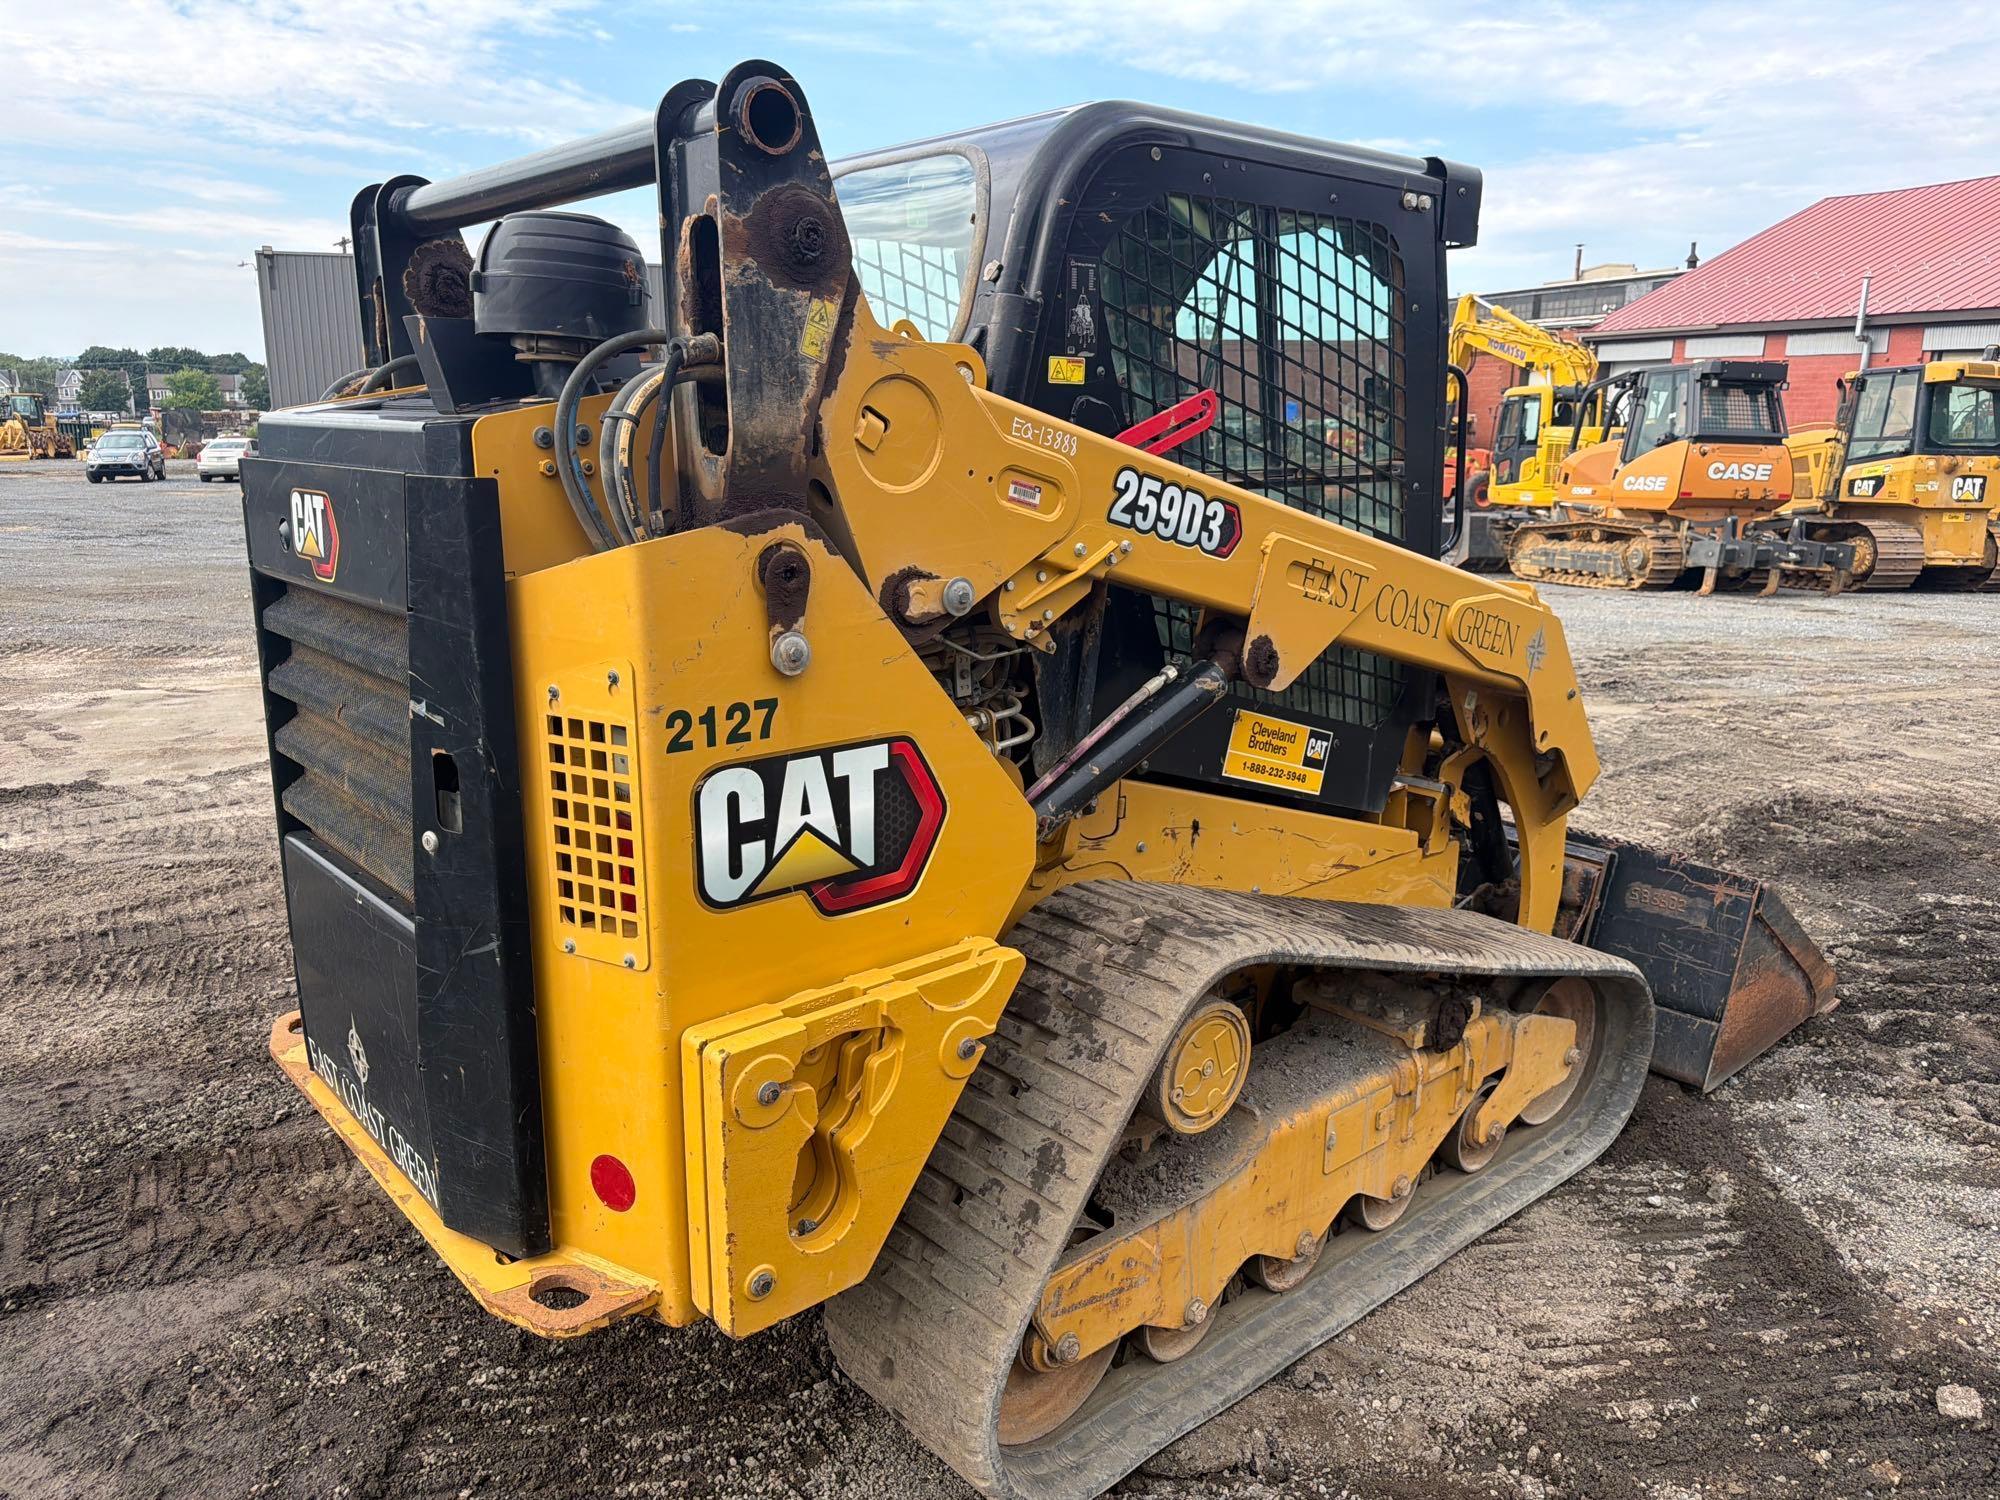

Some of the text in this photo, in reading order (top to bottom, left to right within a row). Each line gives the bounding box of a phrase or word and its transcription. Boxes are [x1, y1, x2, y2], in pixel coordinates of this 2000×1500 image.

[1487, 337, 1526, 361] KOMATSU
[1011, 416, 1079, 457] EQ-13888
[1707, 461, 1773, 481] CASE
[1622, 475, 1668, 492] CASE
[1853, 479, 1876, 496] CAT
[1951, 477, 1984, 501] CAT
[1109, 470, 1225, 552] 259D3
[291, 491, 325, 558] CAT
[1302, 557, 1521, 659] EAST COAST GREEN
[665, 697, 779, 755] 2127
[1251, 721, 1298, 744] Cleveland
[1248, 734, 1288, 757] Brothers
[1307, 737, 1328, 761] CAT
[1242, 760, 1307, 784] 1-888-232-5948
[699, 743, 889, 903] CAT
[307, 1036, 439, 1208] EAST COAST GREEN
